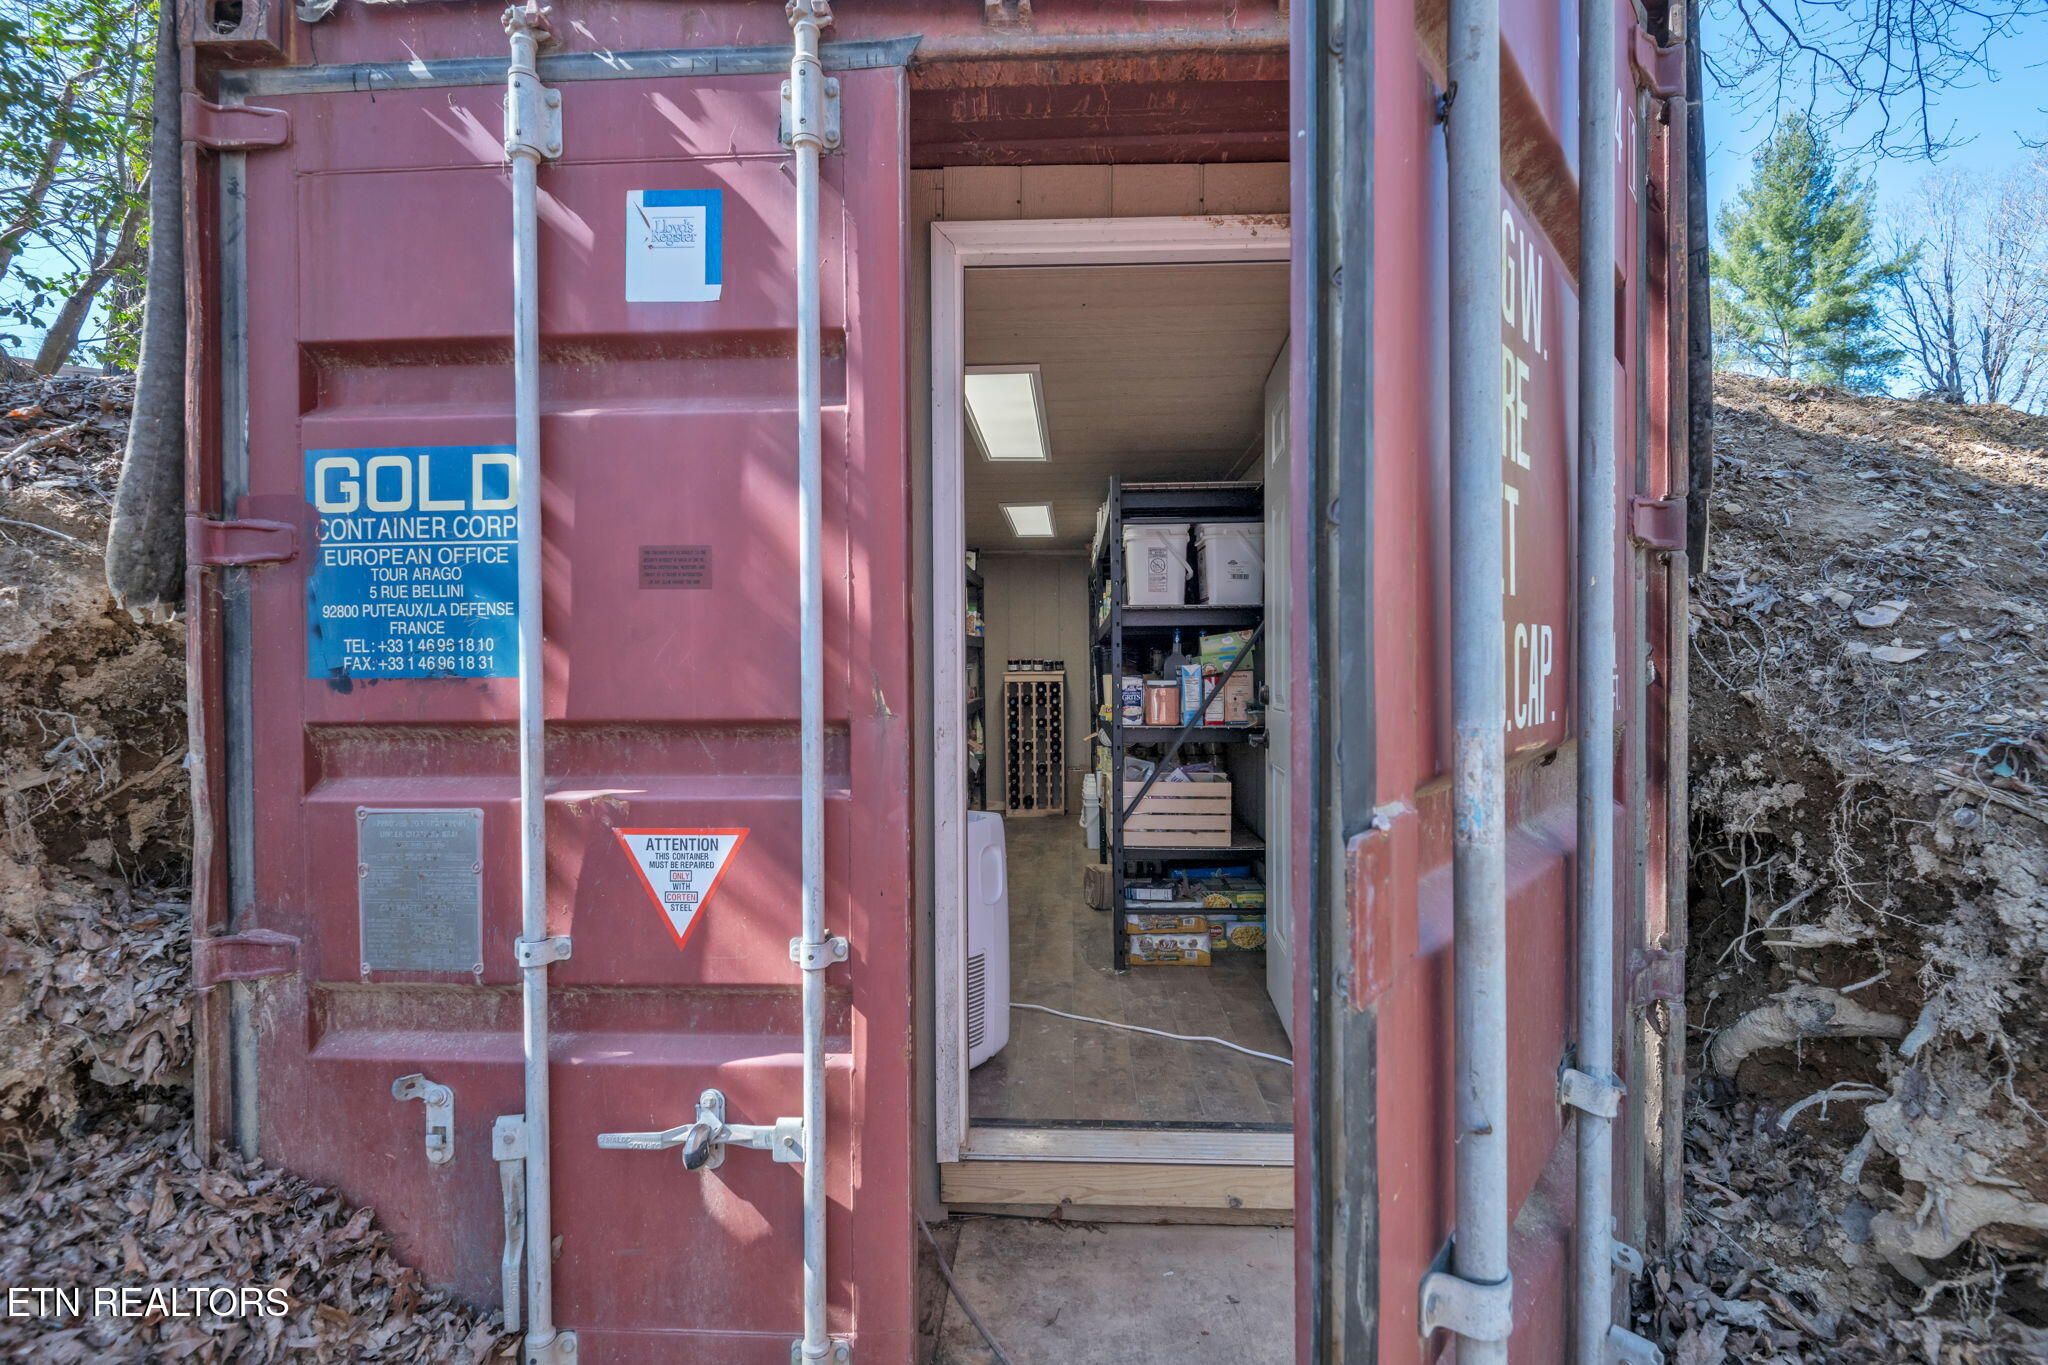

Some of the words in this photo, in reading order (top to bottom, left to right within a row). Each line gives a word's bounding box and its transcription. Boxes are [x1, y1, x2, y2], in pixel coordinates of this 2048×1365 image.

[1615, 88, 1623, 164] 4
[655, 219, 694, 234] Lloyd's
[651, 230, 697, 246] Register
[1501, 208, 1548, 361] GW.
[315, 454, 517, 513] GOLD
[315, 517, 446, 541] CONTAINER
[453, 515, 516, 538] CORP
[324, 548, 431, 566] EUROPEAN
[438, 546, 509, 564] OFFICE
[370, 568, 408, 581] TOUR
[412, 567, 462, 581] ARAGO
[369, 586, 377, 598] 5
[381, 585, 409, 598] RUE
[412, 584, 464, 598] BELLINI
[322, 604, 359, 618] 92800
[362, 603, 447, 618] PUTEAUX/LA
[451, 602, 515, 617] DEFENSE
[390, 621, 446, 635] FRANCE
[378, 639, 404, 652] +33
[408, 639, 414, 652] 1
[418, 639, 435, 652] 46
[437, 639, 455, 652] 96
[458, 638, 474, 651] 18
[477, 638, 494, 651] 10
[343, 657, 376, 671] FAX:
[378, 656, 404, 670] +33
[408, 656, 414, 670] 1
[418, 656, 435, 670] 46
[438, 656, 455, 670] 96
[458, 656, 475, 669] 18
[478, 655, 494, 669] 31
[1502, 621, 1556, 732] .CAP.
[646, 837, 719, 851] ATTENTION
[649, 861, 668, 869] MUST
[670, 861, 679, 869] BE
[680, 861, 715, 869] REPAIRED
[672, 872, 690, 880] ONLY
[670, 904, 693, 912] STEEL
